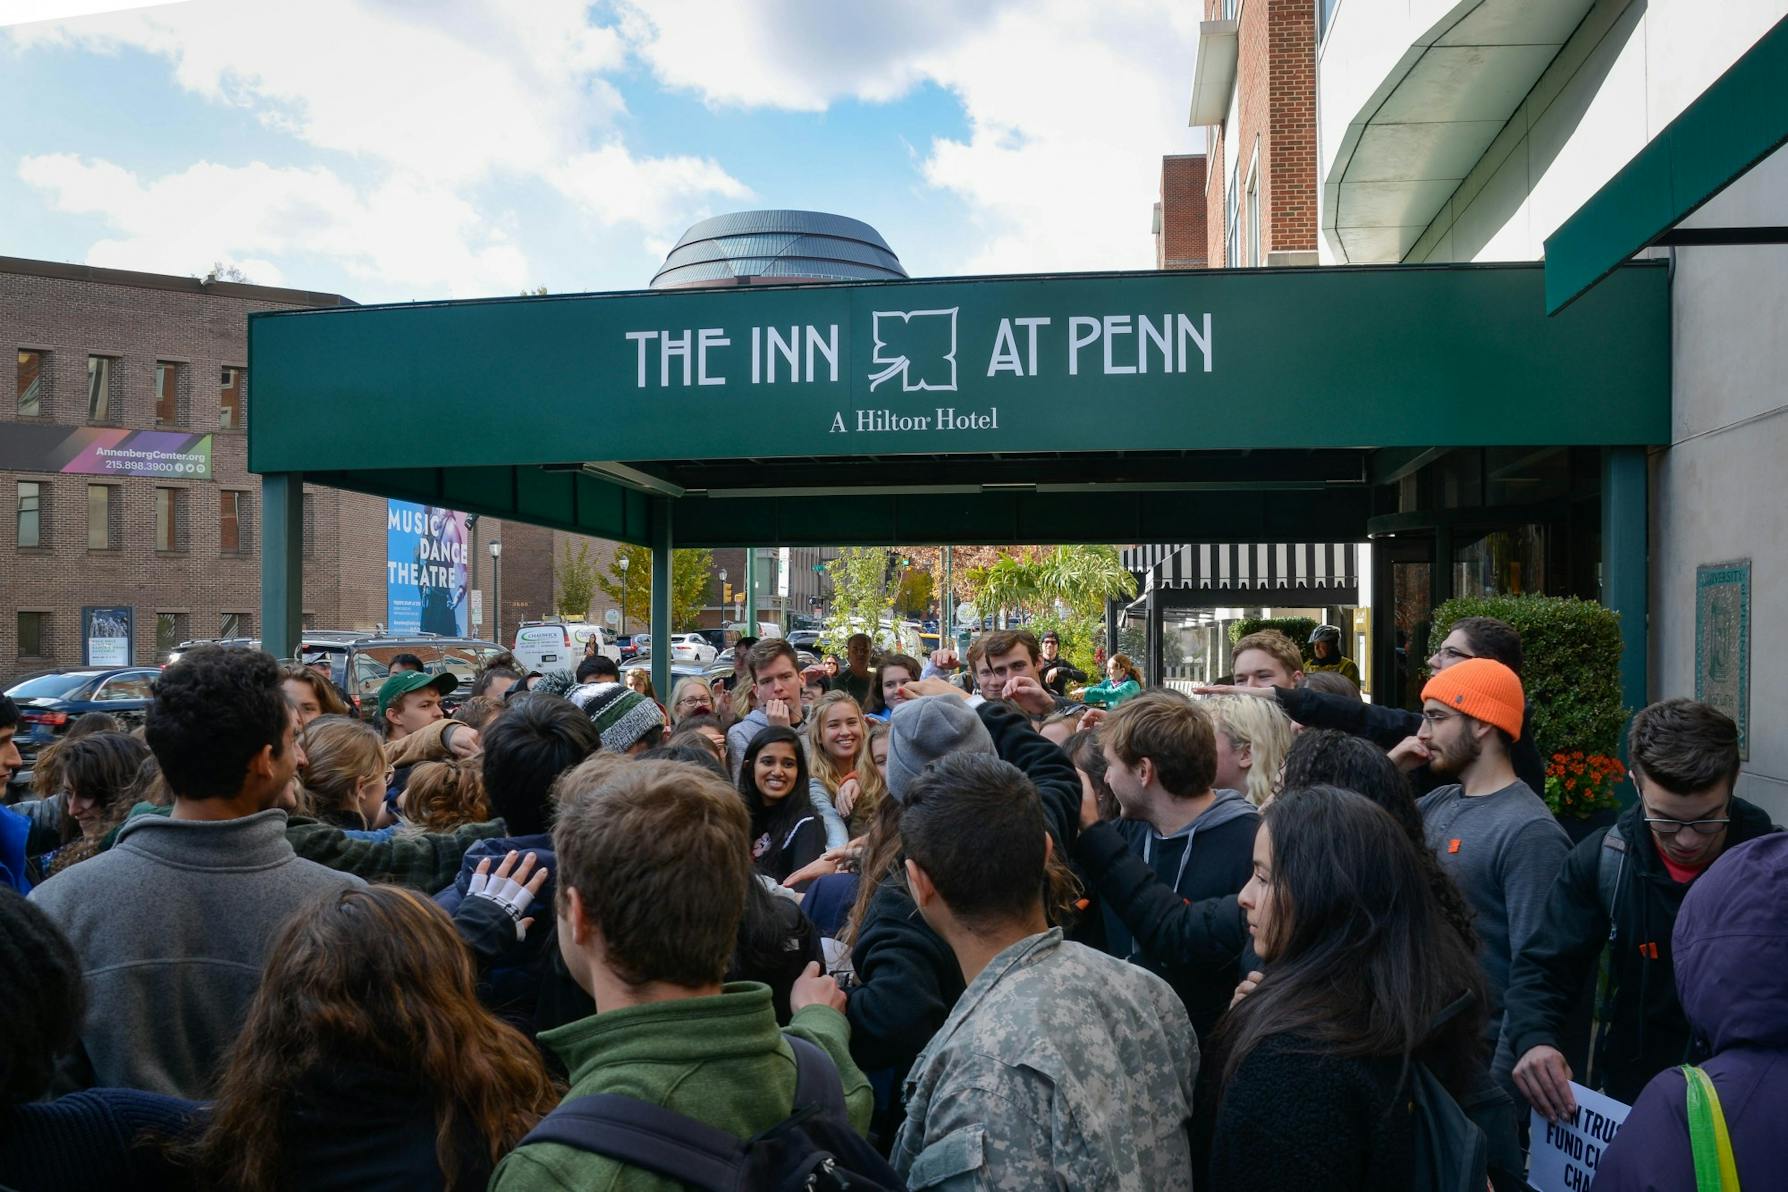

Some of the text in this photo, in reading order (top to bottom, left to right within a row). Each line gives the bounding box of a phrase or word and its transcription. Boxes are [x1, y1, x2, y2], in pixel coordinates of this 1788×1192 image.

[625, 312, 1213, 388] THE INN AT PENN
[829, 407, 999, 433] A Hilton Hotel
[96, 447, 206, 463] AnnenbergCenter.org
[105, 460, 173, 472] 215.898.3900
[388, 507, 440, 537] MUSIC
[420, 538, 468, 565] DANCE
[388, 561, 456, 589] THEATRE
[1546, 1122, 1583, 1161] FUND
